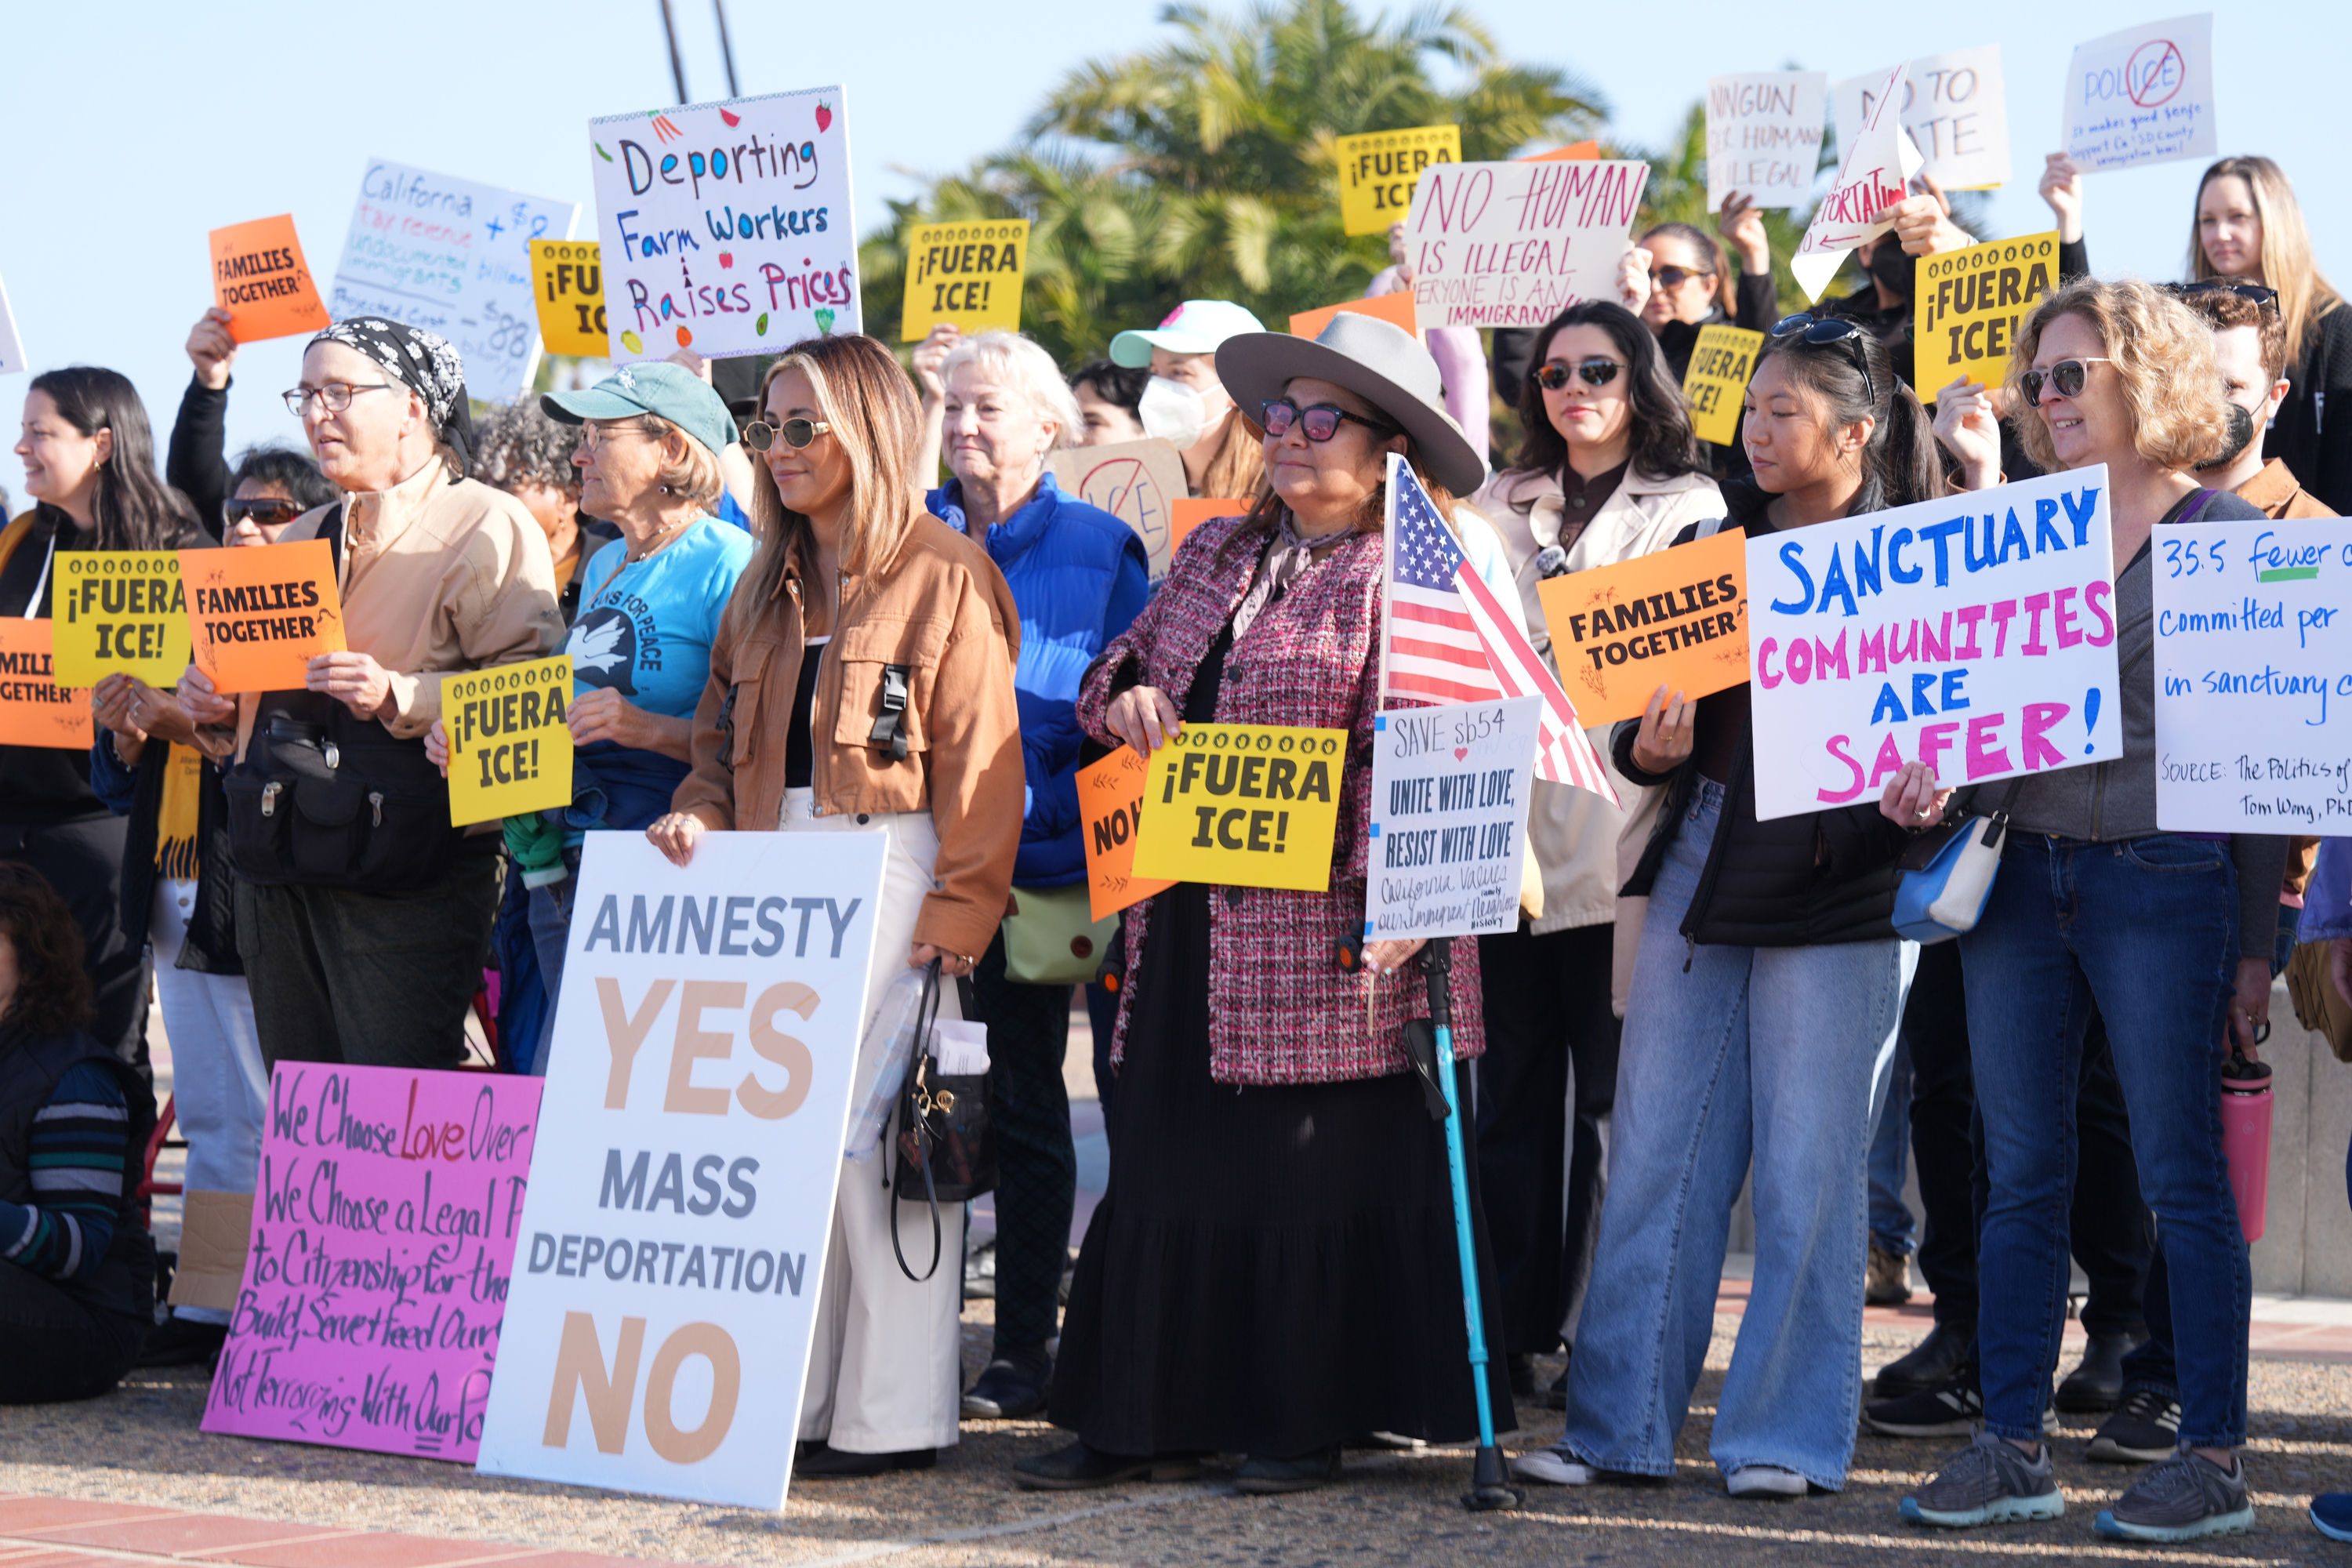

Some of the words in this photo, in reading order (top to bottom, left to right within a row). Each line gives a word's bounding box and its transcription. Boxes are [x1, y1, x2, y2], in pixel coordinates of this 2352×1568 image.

[1926, 68, 1979, 103] TO
[2085, 56, 2176, 106] POLICE
[619, 133, 818, 199] Deporting
[1352, 148, 1450, 187] ¡FUERA
[363, 163, 473, 220] California
[1374, 182, 1417, 209] IC
[1417, 169, 1493, 234] NO
[1506, 164, 1646, 231] HUMAN
[359, 200, 394, 231] tax
[401, 215, 472, 249] revenue
[617, 209, 700, 262] Farm
[706, 205, 828, 241] Workers
[217, 247, 295, 283] FAMILIES
[353, 232, 469, 273] undocumented
[916, 244, 1018, 285] ¡FUERA
[1419, 240, 1447, 275] IS
[1464, 236, 1577, 276] ILLEGAL
[222, 276, 300, 307] TOGETHER
[545, 263, 601, 303] ¡FU
[626, 267, 750, 332] Raises
[932, 281, 991, 312] ICE!
[1414, 276, 1490, 304] ERYONE
[1499, 276, 1520, 302] IS
[1526, 277, 1572, 307] AN
[1926, 262, 2050, 333] ¡FUERA
[575, 304, 609, 335] IC
[1947, 315, 2020, 365] ICE!
[1690, 382, 1722, 416] CE!
[1770, 485, 2102, 617] SANCTUARY
[2161, 539, 2227, 579] 35.5
[67, 578, 188, 624] ¡FUERA
[196, 580, 320, 615] FAMILIES
[1569, 573, 1737, 643] FAMILIES
[95, 622, 165, 659] ICE!
[205, 615, 316, 646] TOGETHER
[620, 593, 650, 619] FOR
[637, 615, 662, 672] PEACE
[1585, 611, 1737, 670] TOGETHER
[1758, 579, 2115, 690] COMMUNITIES
[2298, 607, 2339, 649] per
[0, 652, 54, 677] MILI
[0, 681, 72, 704] GETHER
[1870, 668, 1971, 727] ARE
[2165, 668, 2192, 697] in
[2201, 664, 2328, 727] sanctuary
[454, 686, 568, 754] ¡FUERA
[1394, 713, 1446, 759] SAVE
[477, 739, 539, 789] ICE!
[1816, 687, 2102, 804] SAFER!
[1162, 753, 1331, 804] ¡FUERA
[1389, 776, 1435, 817] UNITE
[1438, 772, 1477, 813] WITH
[1478, 768, 1515, 808] LOVE,
[2234, 754, 2265, 782] The
[2267, 756, 2332, 781] Politics
[2336, 757, 2351, 794] of
[2240, 793, 2272, 817] Tom
[1093, 808, 1130, 857] NO
[1191, 806, 1290, 854] ICE!
[1385, 829, 1438, 869] RESIST
[1440, 825, 1477, 864] WITH
[1478, 820, 1515, 860] LOVE
[584, 894, 862, 959] AMNESTY
[593, 976, 822, 1121] YES
[273, 1069, 310, 1148] We
[315, 1072, 398, 1158] Choose
[400, 1077, 466, 1162] Love
[470, 1083, 530, 1163] Over
[598, 1148, 761, 1220] MASS
[264, 1155, 302, 1224] We
[308, 1158, 389, 1235] Choose
[395, 1200, 414, 1233] a
[420, 1170, 497, 1265] Legal
[252, 1228, 280, 1288] to
[281, 1228, 422, 1306] Citizenship
[470, 1245, 510, 1305] tho
[528, 1231, 808, 1298] DEPORTATION
[213, 1342, 258, 1417] Not
[361, 1363, 412, 1432] With
[415, 1370, 458, 1435] Our
[541, 1309, 742, 1465] NO
